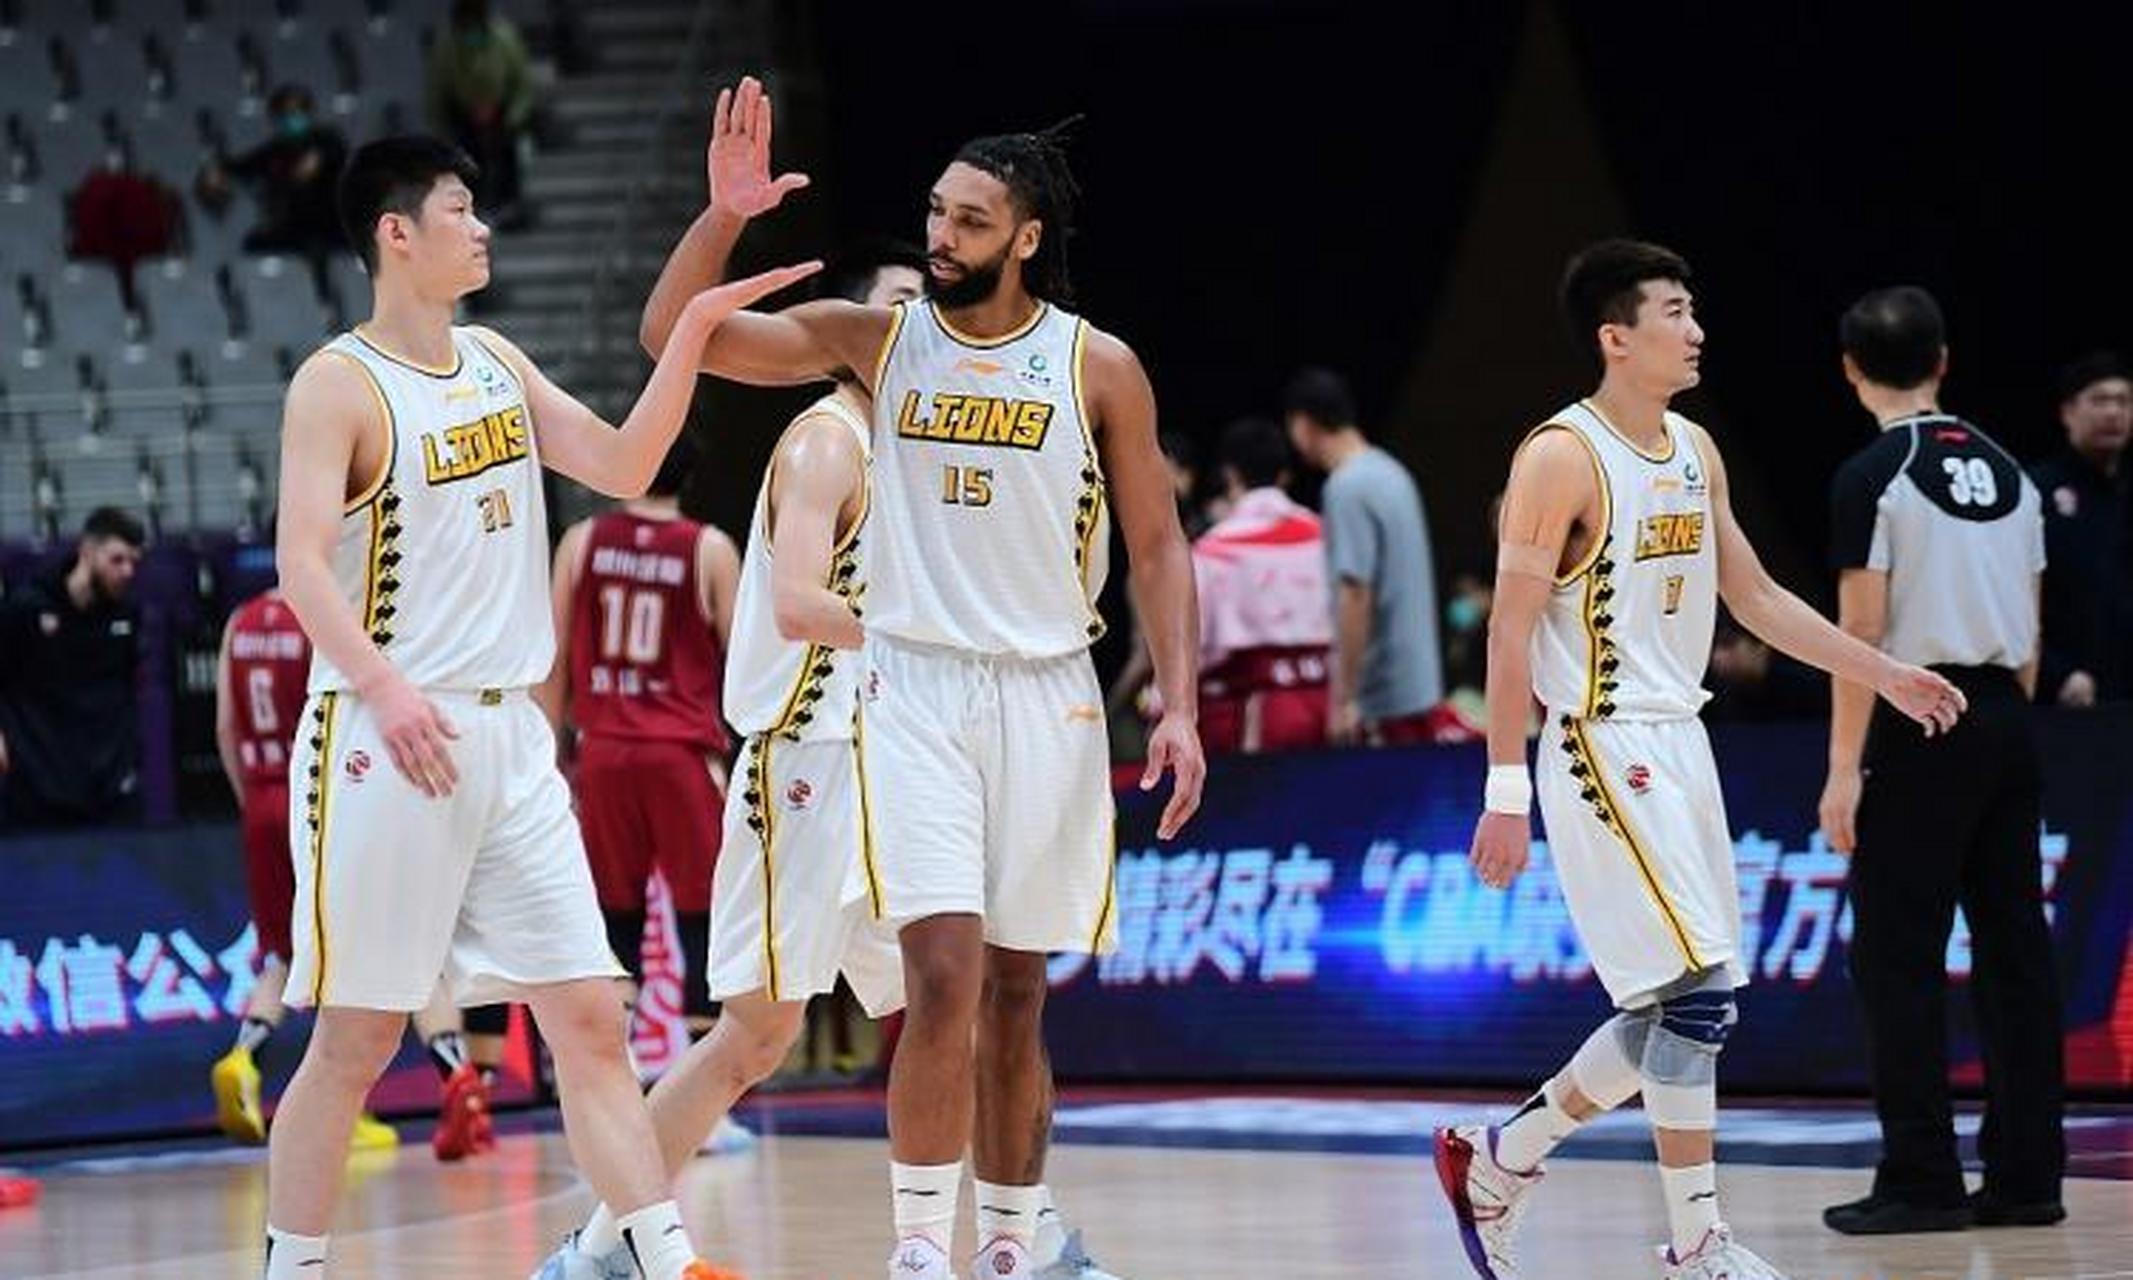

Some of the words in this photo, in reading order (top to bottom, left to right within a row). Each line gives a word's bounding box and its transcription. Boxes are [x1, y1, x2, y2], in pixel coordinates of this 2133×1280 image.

[423, 404, 527, 485] LIONS
[898, 389, 1054, 450] LIONS
[942, 465, 993, 507] 15
[1941, 456, 1998, 506] 39
[601, 587, 664, 661] 10
